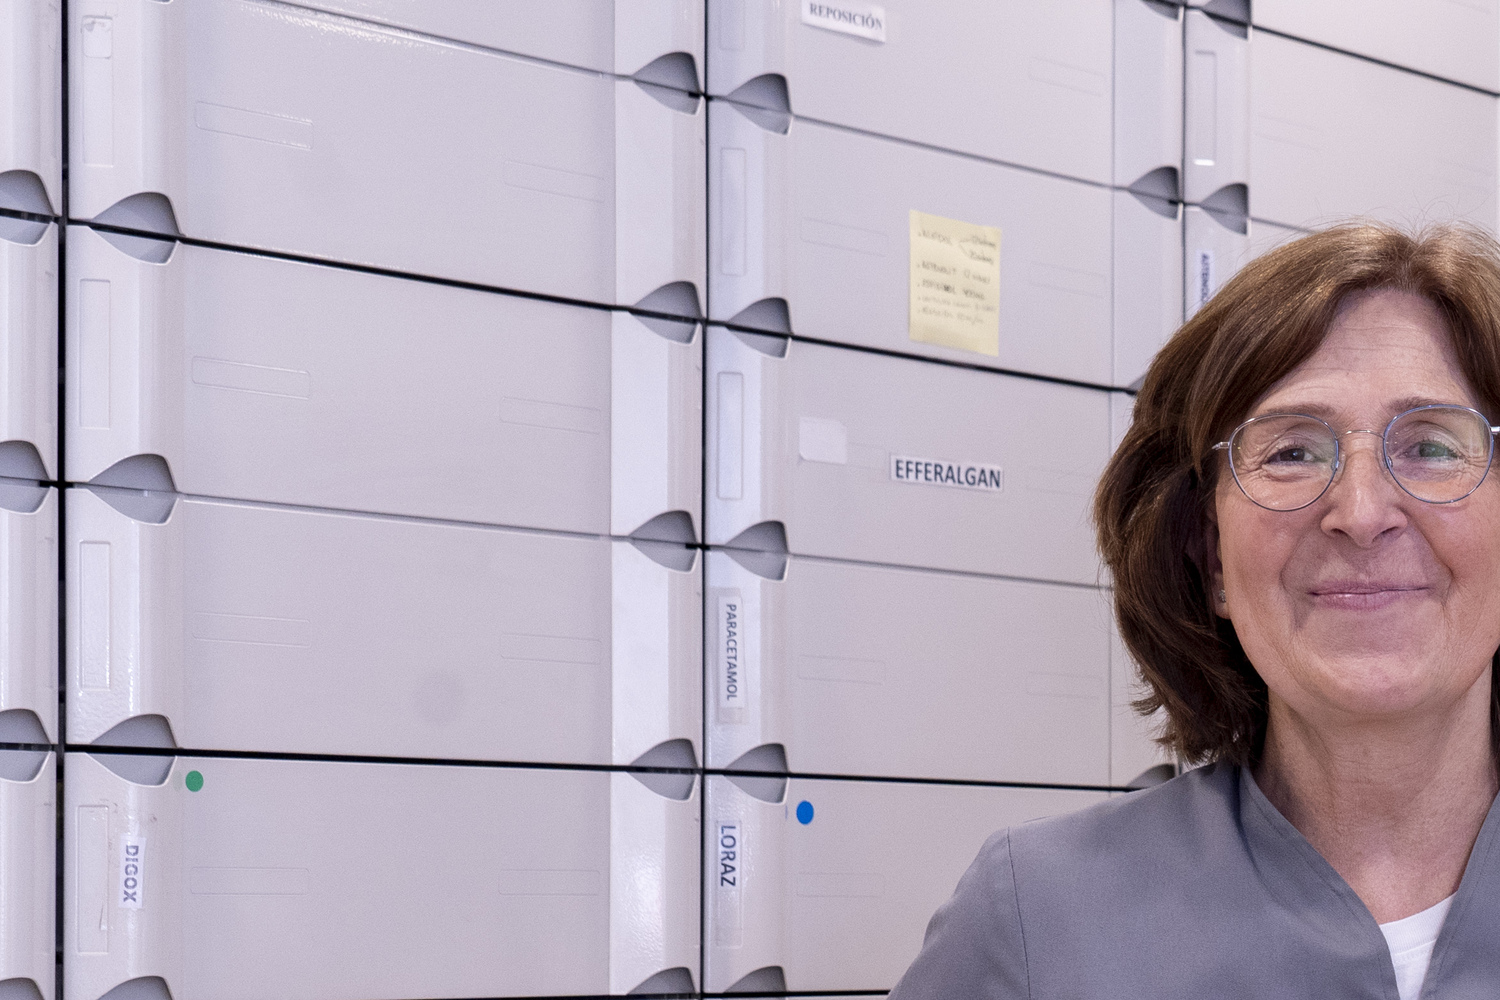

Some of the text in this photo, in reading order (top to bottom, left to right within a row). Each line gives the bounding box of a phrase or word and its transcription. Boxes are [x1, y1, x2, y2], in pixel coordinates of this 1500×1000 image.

[809, 2, 882, 30] REPOSICIÓN
[895, 459, 1000, 488] EFFERALGAN
[726, 603, 738, 701] PARACETAMOL
[123, 845, 139, 903] DIGOX
[720, 825, 737, 887] LORAZ
